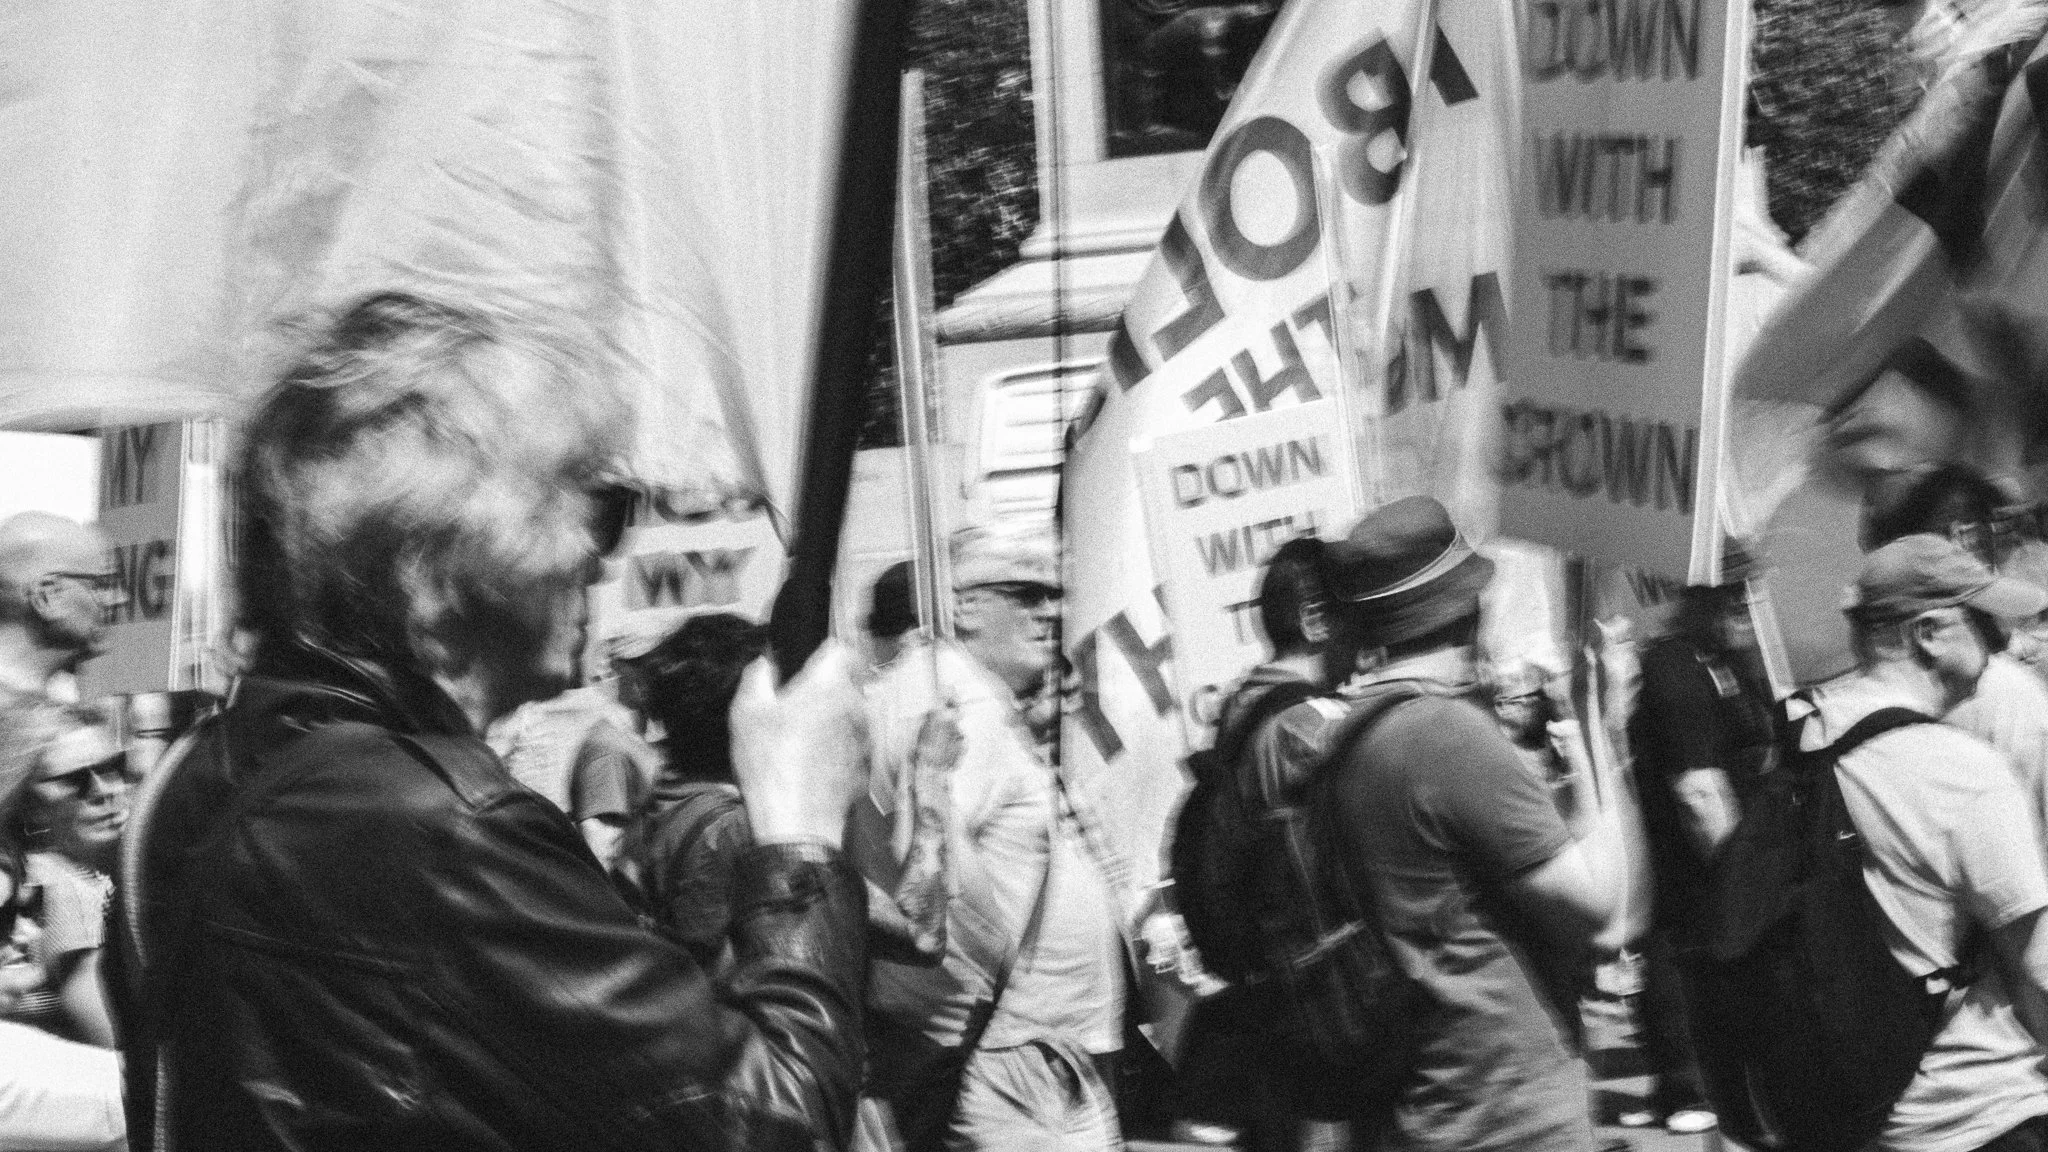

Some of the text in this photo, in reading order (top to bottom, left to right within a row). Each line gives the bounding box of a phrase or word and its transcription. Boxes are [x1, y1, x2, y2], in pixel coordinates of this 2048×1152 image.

[1524, 0, 1702, 83] DOWN
[1533, 131, 1682, 224] WITH
[1545, 268, 1656, 366] THE
[1169, 436, 1328, 510] DOWN
